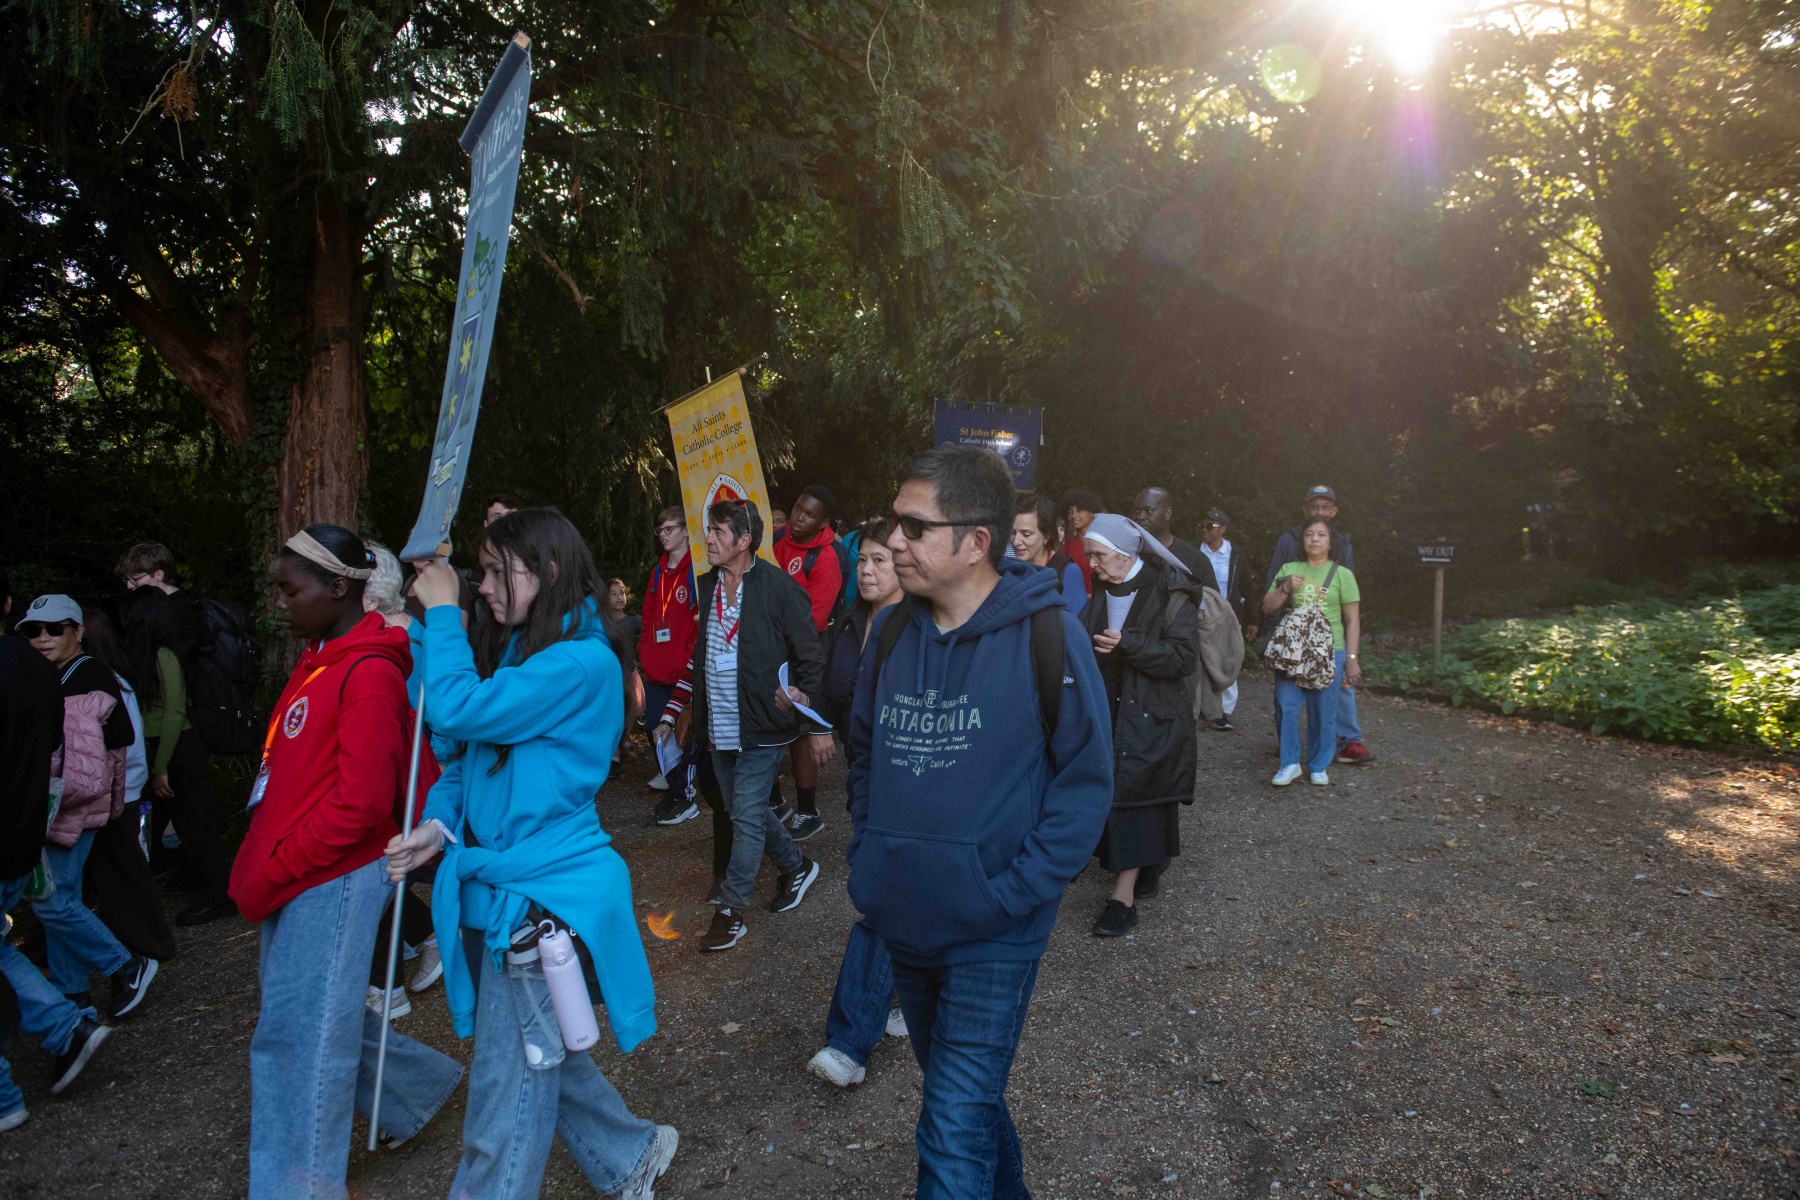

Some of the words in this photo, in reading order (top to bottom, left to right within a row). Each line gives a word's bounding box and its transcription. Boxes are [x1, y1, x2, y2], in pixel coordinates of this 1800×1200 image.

[692, 419, 703, 434] All
[704, 410, 726, 428] Saints
[682, 434, 714, 456] Catholic
[714, 421, 743, 441] College
[960, 427, 968, 436] St
[970, 428, 989, 437] John
[991, 429, 1015, 439] Fisher
[710, 482, 719, 495] ALL
[724, 477, 742, 494] SAINTS
[1435, 546, 1455, 557] OUT
[879, 704, 982, 734] PATAGONIA
